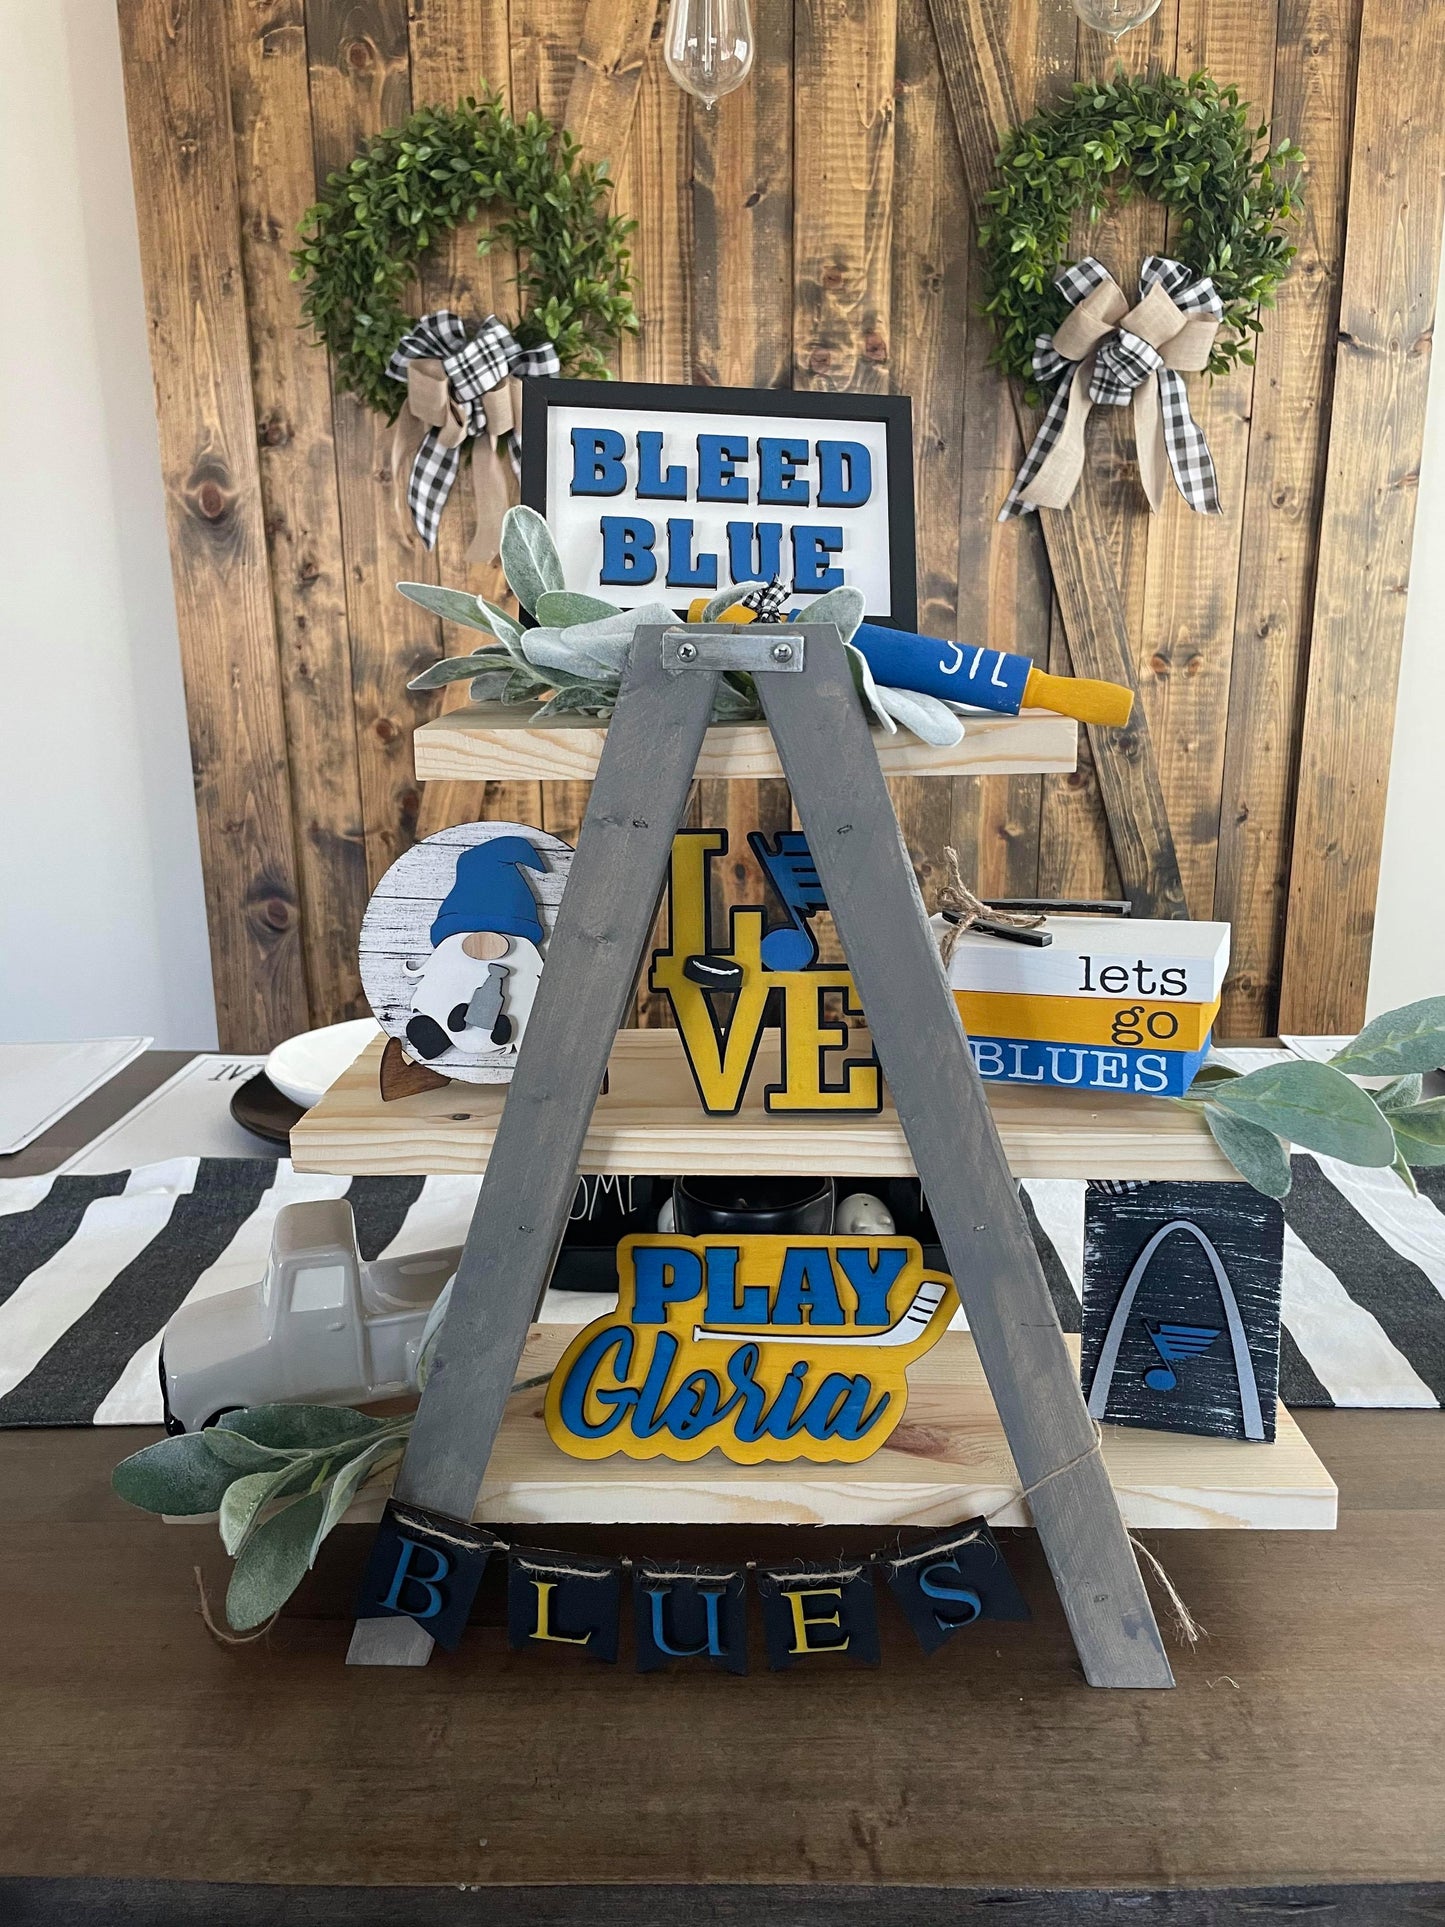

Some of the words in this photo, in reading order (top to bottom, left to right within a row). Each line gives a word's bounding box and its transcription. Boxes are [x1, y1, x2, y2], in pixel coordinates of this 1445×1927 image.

[570, 427, 872, 508] BLEED
[600, 516, 844, 594] BLUE
[1078, 956, 1188, 996] lets
[1111, 1006, 1179, 1046] go
[969, 1040, 1169, 1093] BLUES
[631, 1246, 908, 1326] PLAY
[559, 1325, 892, 1443] Gloria
[376, 1534, 983, 1657] BLUES
